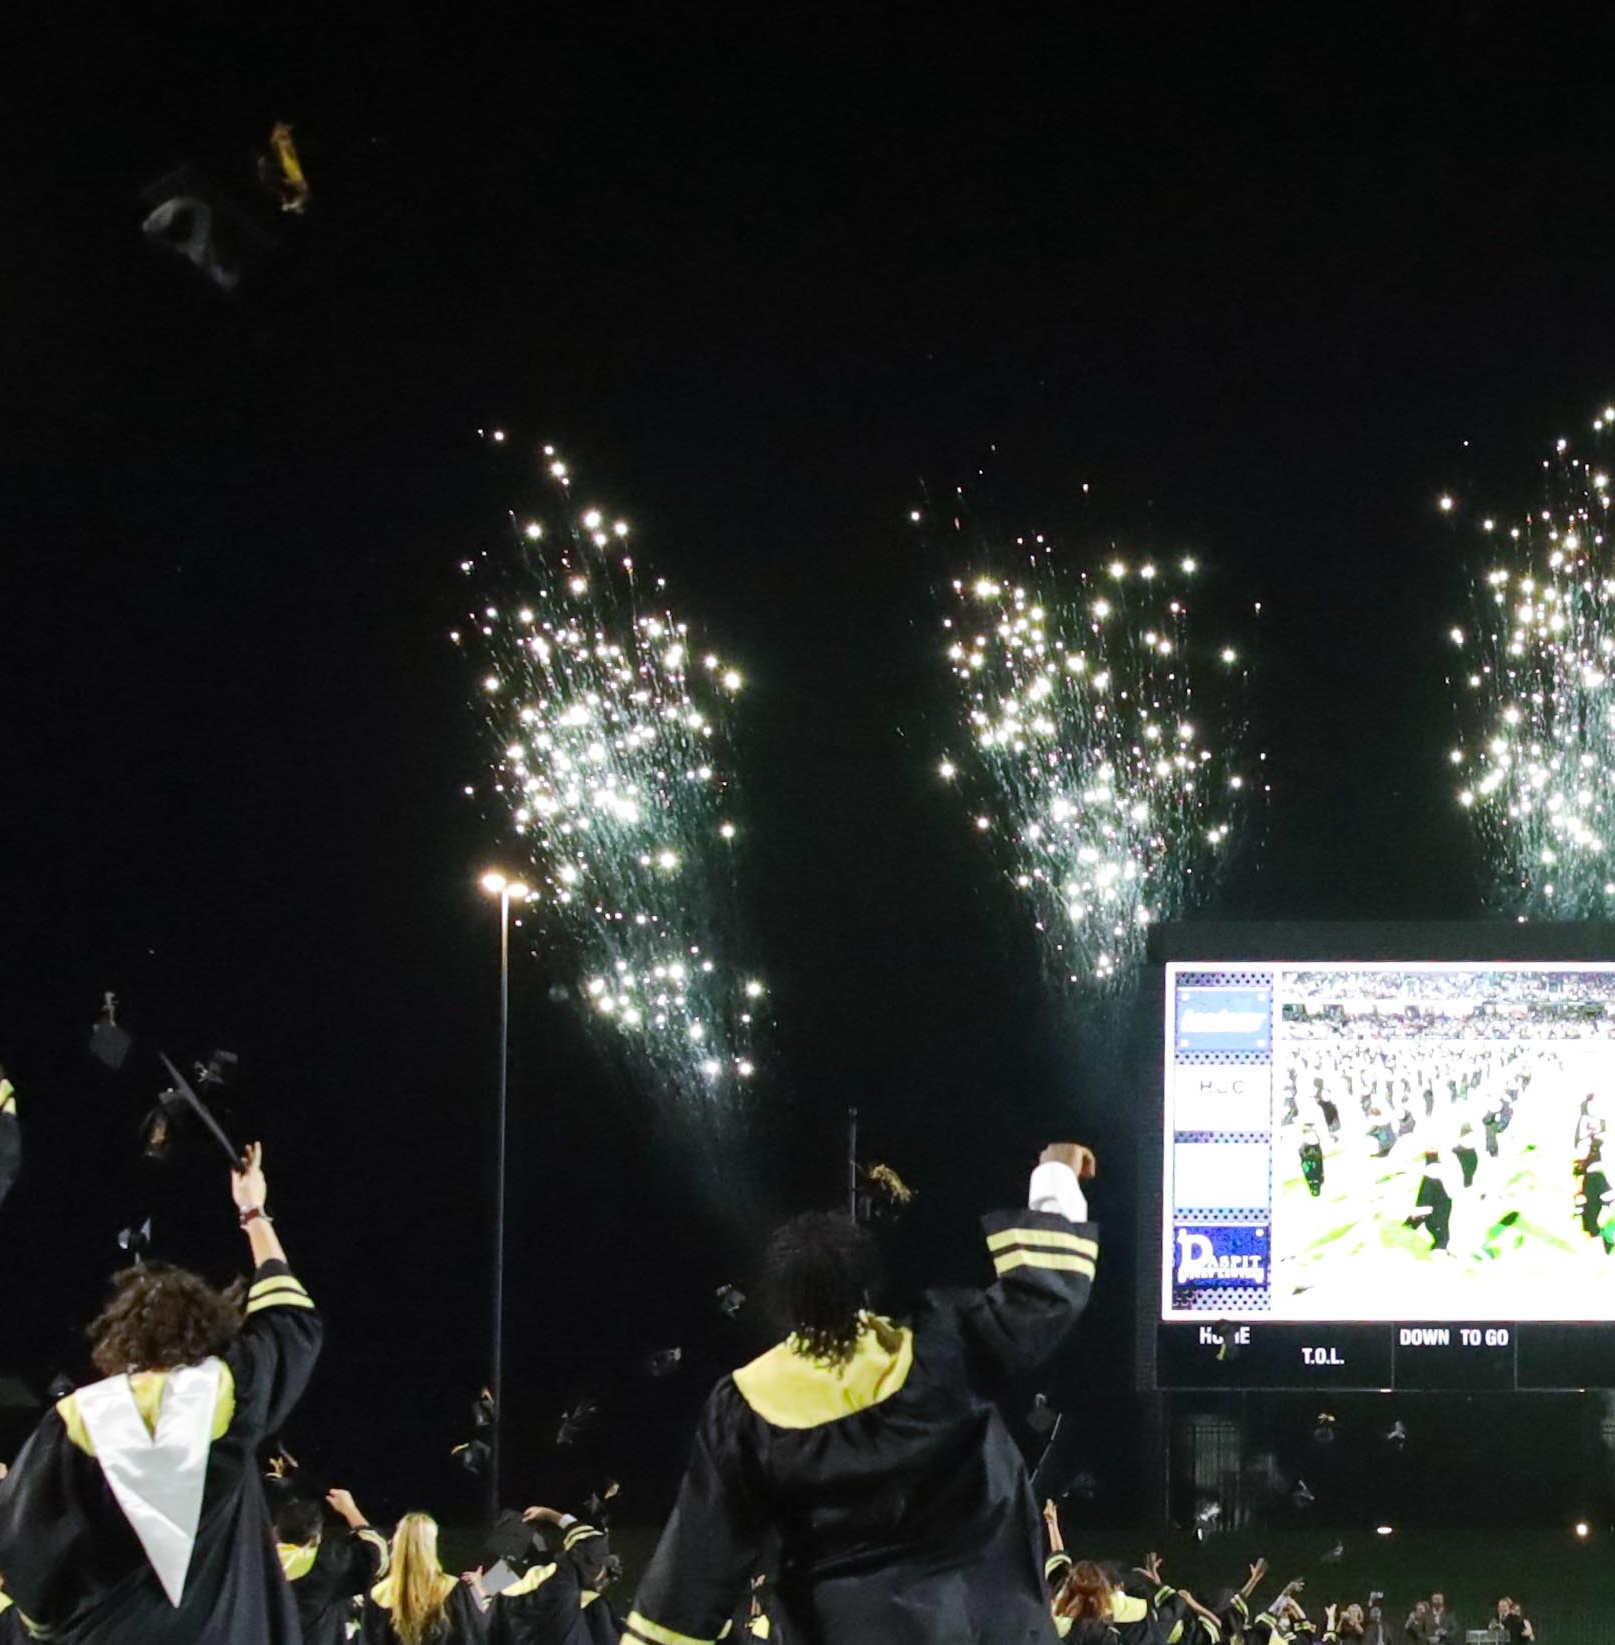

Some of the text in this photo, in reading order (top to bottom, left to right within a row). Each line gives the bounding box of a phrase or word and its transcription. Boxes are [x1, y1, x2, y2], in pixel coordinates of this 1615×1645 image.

[1199, 1326, 1251, 1345] HOE
[1399, 1328, 1450, 1346] DOWN
[1459, 1328, 1509, 1346] TO GO
[1301, 1347, 1345, 1365] T.O.L.
